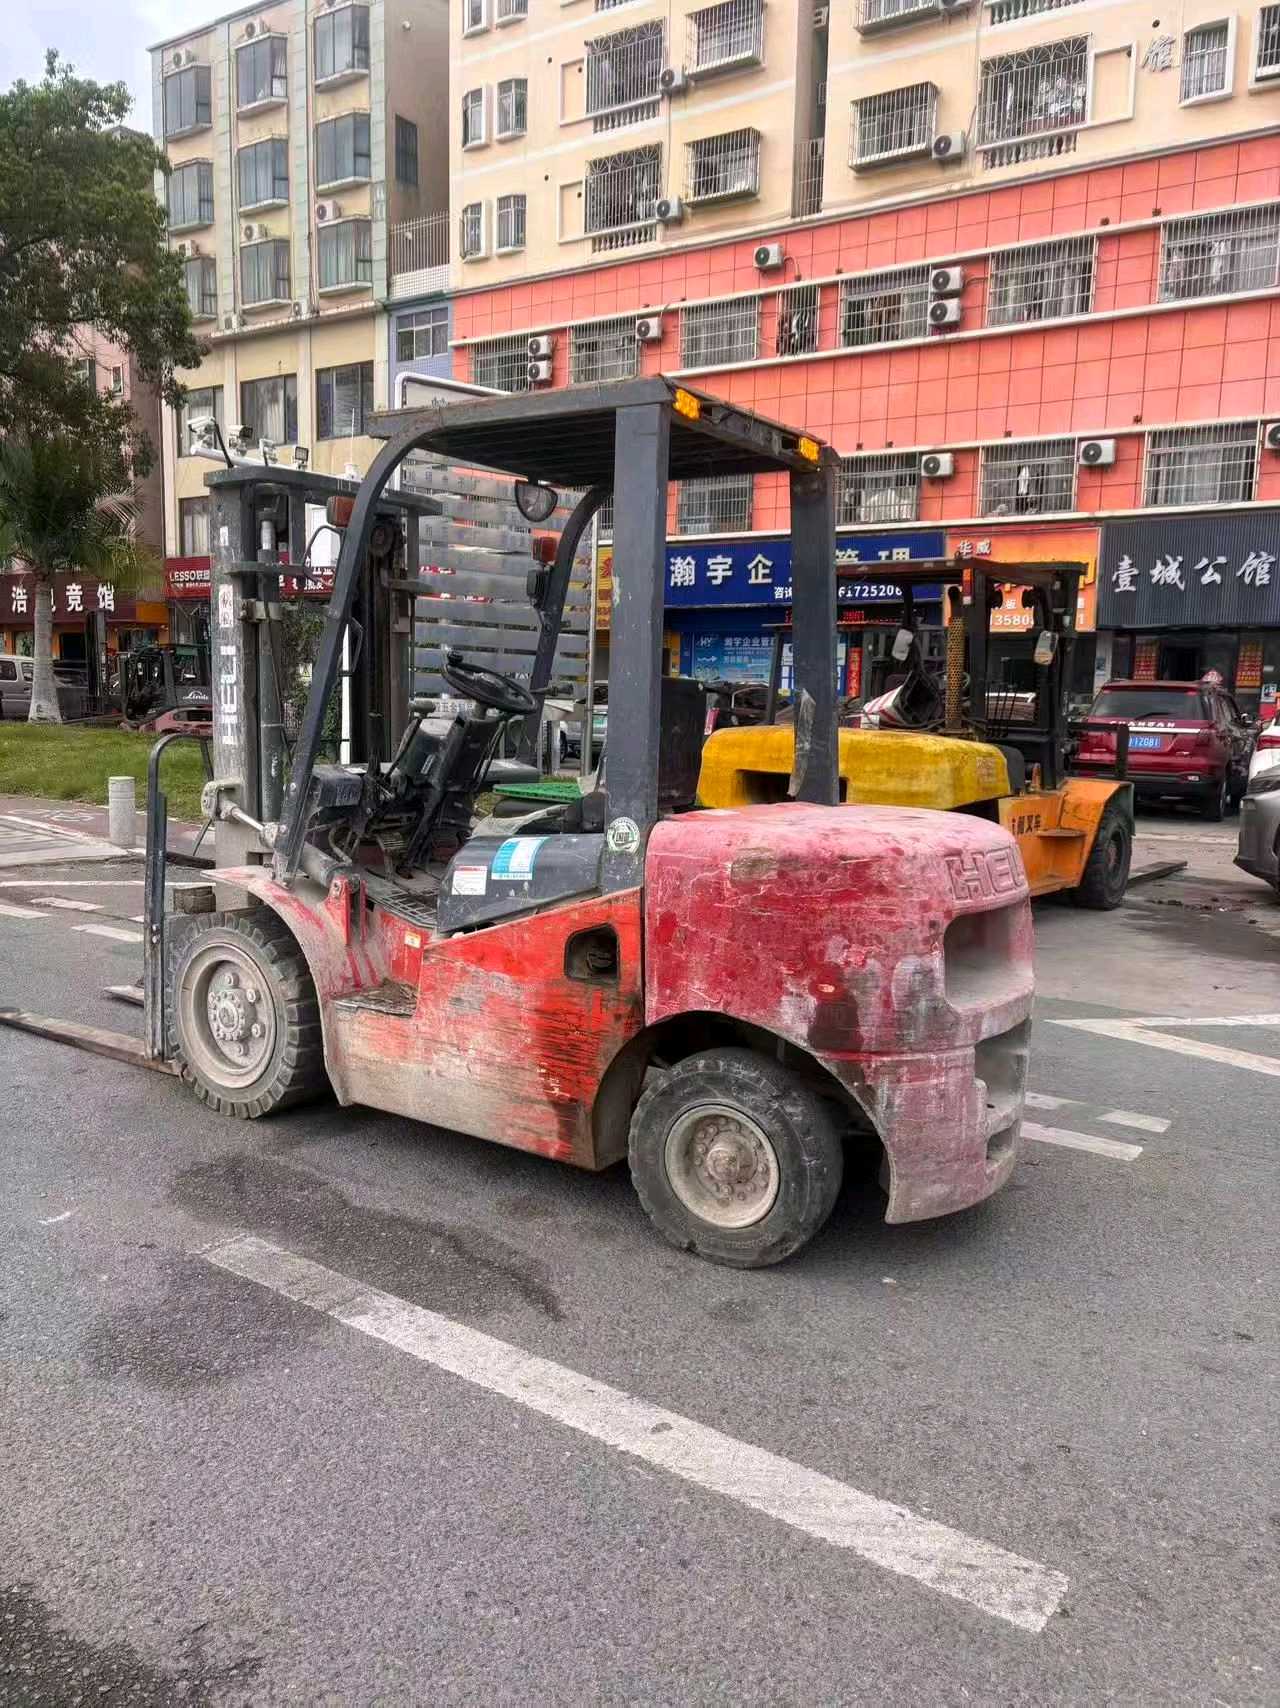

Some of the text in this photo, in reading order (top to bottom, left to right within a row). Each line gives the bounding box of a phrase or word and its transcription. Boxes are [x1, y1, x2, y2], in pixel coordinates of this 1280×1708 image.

[1112, 553, 1276, 592] 壹城公馆
[11, 581, 115, 614] 浩竞馆
[220, 645, 238, 745] HELI
